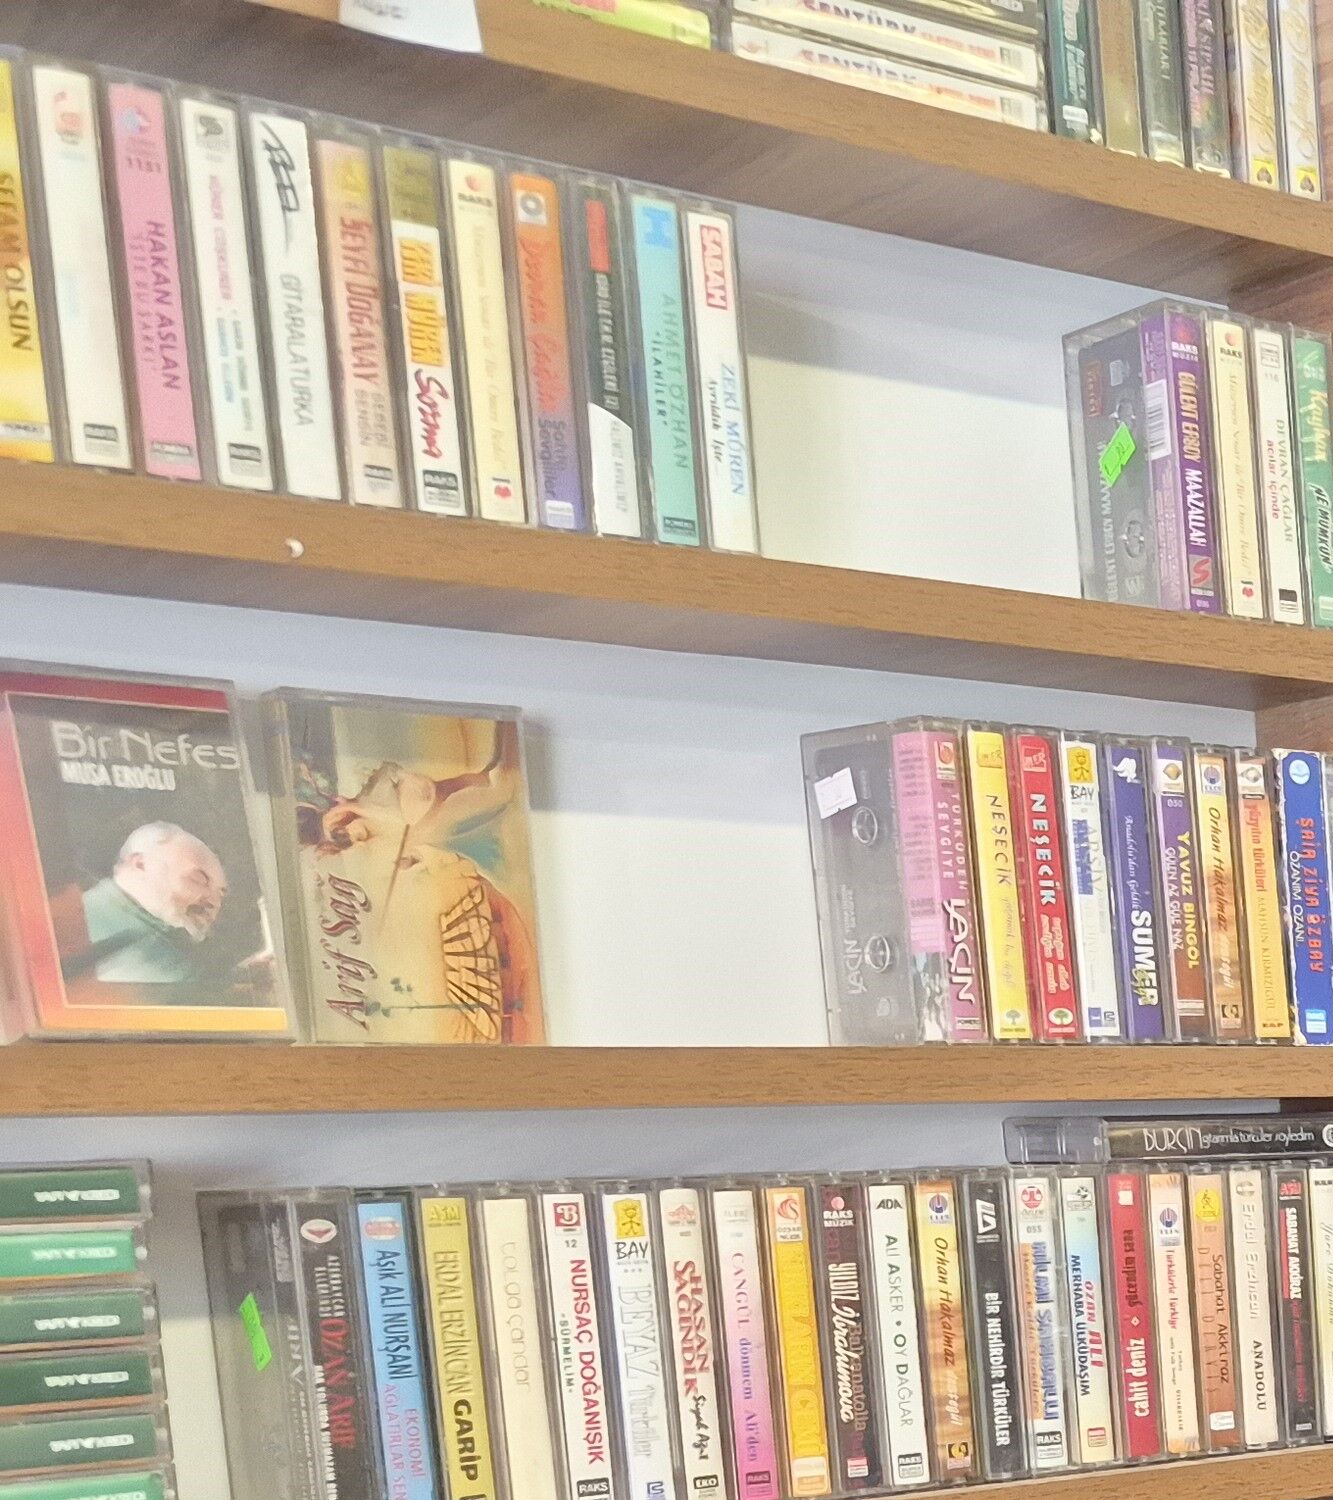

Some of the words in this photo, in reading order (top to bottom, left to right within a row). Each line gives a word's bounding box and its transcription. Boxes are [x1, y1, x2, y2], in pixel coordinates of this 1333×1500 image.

[143, 219, 176, 306] HAKAN
[695, 222, 731, 312] SABAH
[152, 309, 185, 391] ASLAN
[1273, 418, 1289, 480] DEVRAN
[1267, 479, 1281, 520] içinde
[51, 718, 110, 758] Bir
[118, 726, 242, 771] Nefes
[59, 759, 110, 786] MUSA
[985, 792, 1012, 887] NEŞECİK
[1026, 791, 1059, 906] NEŞECİK
[1207, 805, 1223, 852] Orhan
[1168, 882, 1179, 897] AZ
[1211, 855, 1229, 932] Hakalmaz
[1171, 927, 1183, 950] NAZ
[318, 935, 378, 1031] Arif
[614, 1240, 648, 1261] BAY
[569, 1258, 593, 1343] NURSAÇ
[886, 1262, 905, 1312] ASKER
[1069, 1254, 1084, 1317] MERHABA
[689, 1274, 710, 1374] HASAN
[893, 1333, 908, 1357] OY
[433, 1249, 461, 1306] ERDAL
[452, 1397, 483, 1482] GARİP
[895, 1363, 915, 1427] DAĞLAR
[1251, 1339, 1267, 1412] ANADOLU
[577, 1350, 605, 1465] DOĞANIŞIK
[990, 1381, 1011, 1446] TÜRKÜLER
